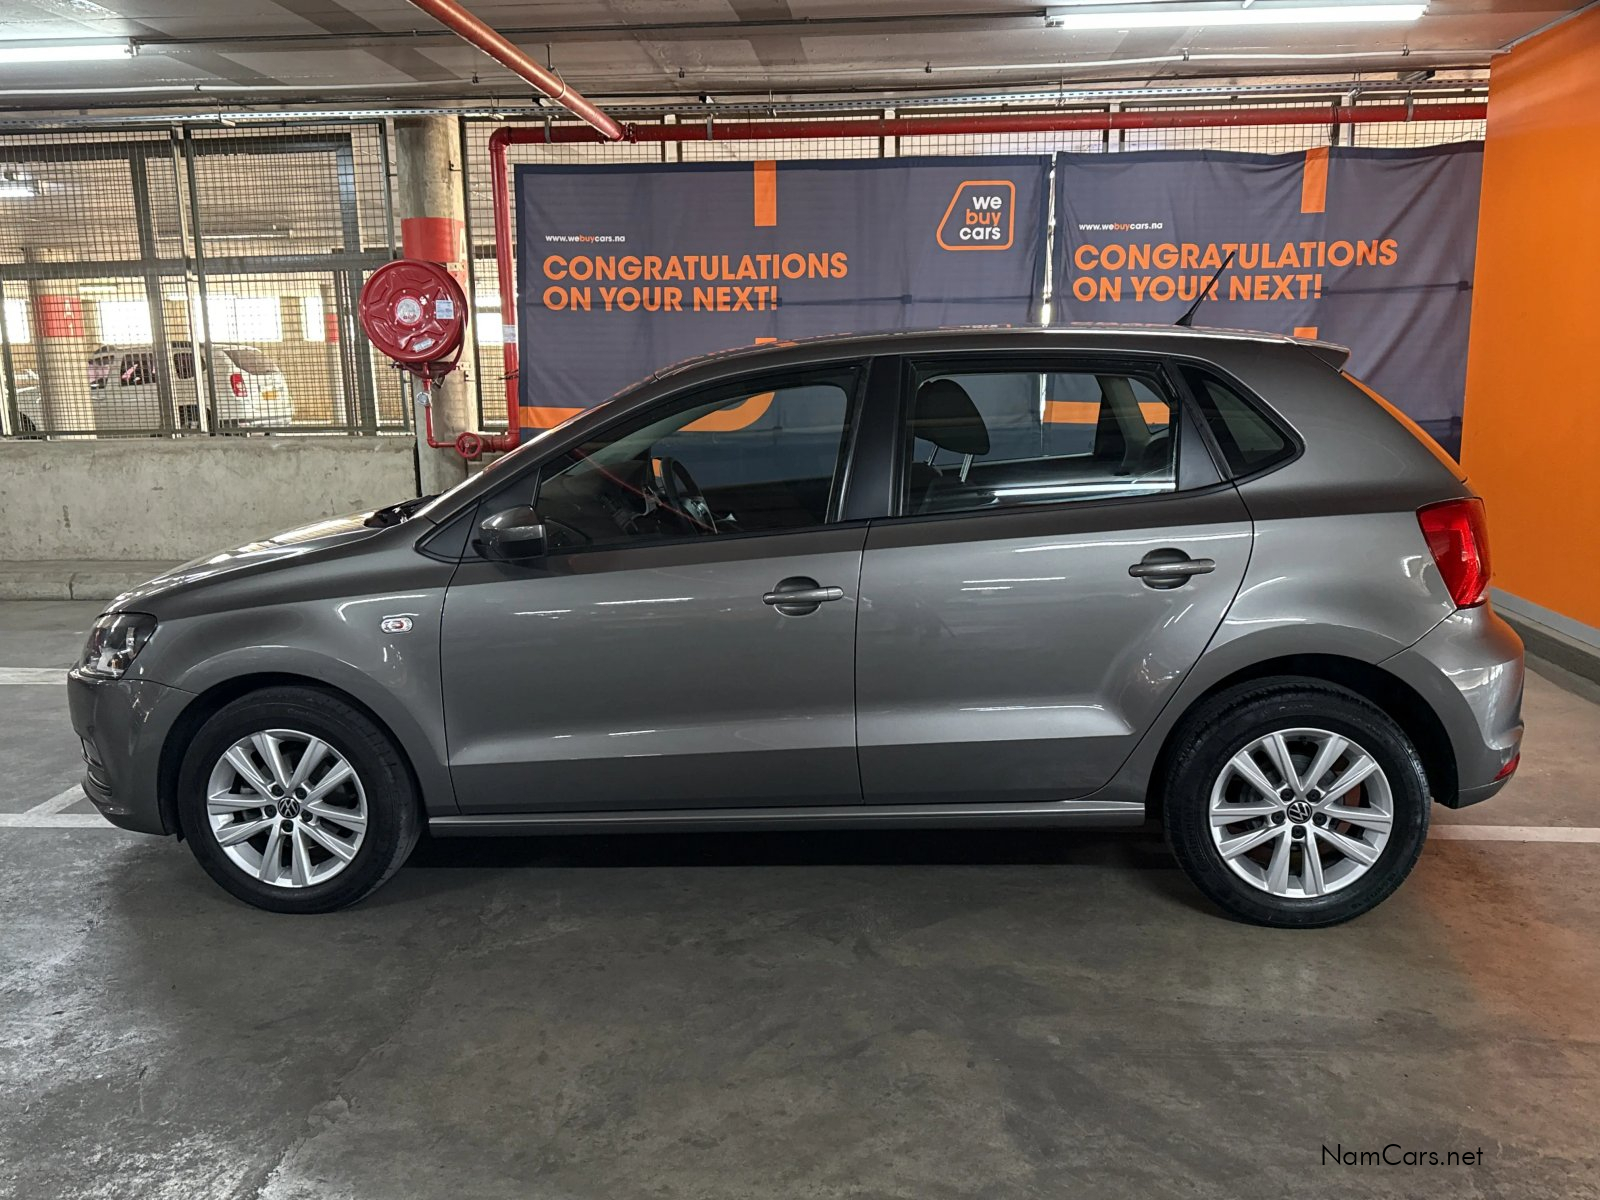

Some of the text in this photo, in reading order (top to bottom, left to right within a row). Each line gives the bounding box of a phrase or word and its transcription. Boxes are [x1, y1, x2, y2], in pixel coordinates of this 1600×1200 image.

[972, 196, 1002, 210] we
[965, 208, 1002, 227] buy
[1078, 222, 1163, 232] www.webuycars.na
[545, 234, 626, 243] www.webuycars.na
[959, 226, 1001, 240] cars
[1074, 239, 1398, 271] CONGRATULATIONS
[543, 251, 848, 281] CONGRATULATIONS
[1072, 273, 1322, 302] ON YOUR NEXT!
[543, 285, 777, 312] ON YOUR NEXT!
